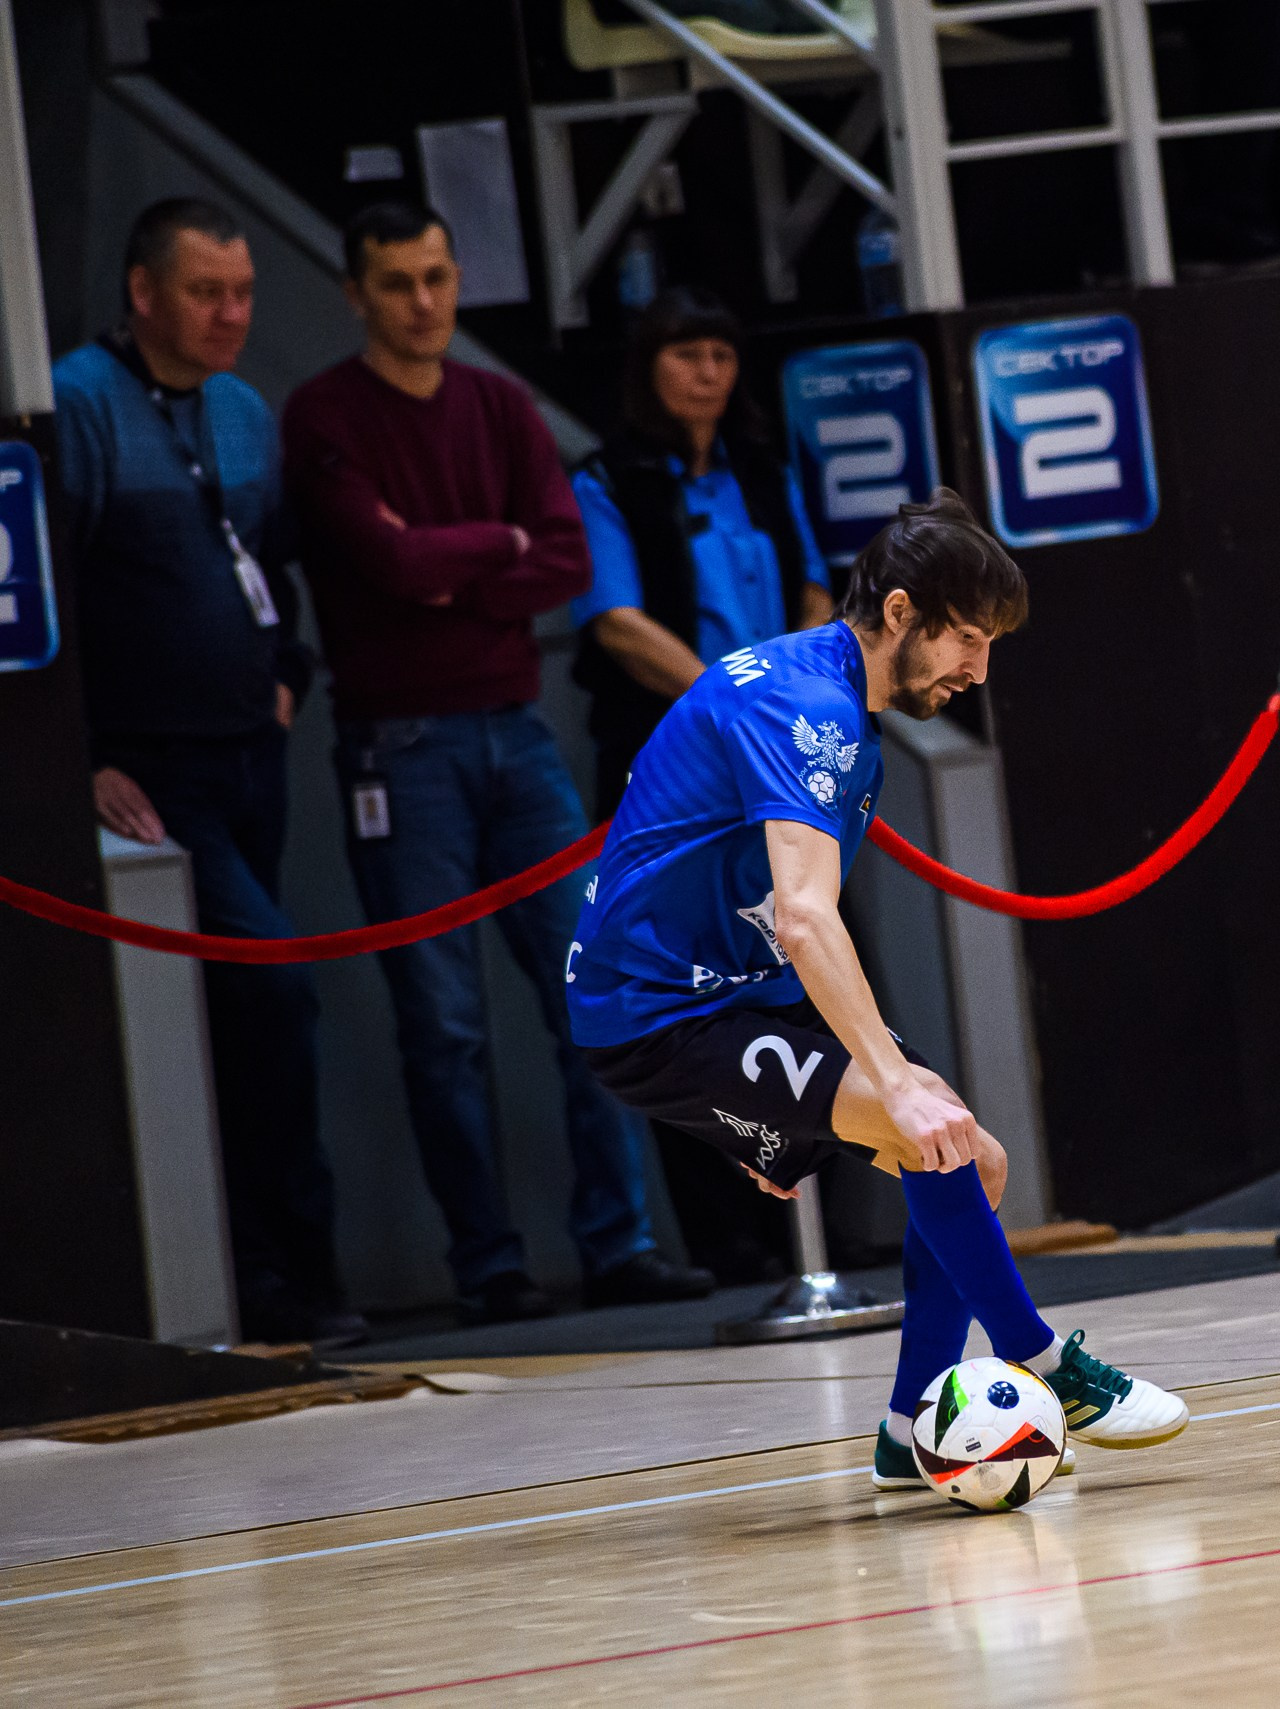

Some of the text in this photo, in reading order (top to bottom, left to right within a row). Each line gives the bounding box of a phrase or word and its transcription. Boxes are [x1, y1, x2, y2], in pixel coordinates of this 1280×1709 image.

[817, 412, 912, 521] 2
[1013, 386, 1122, 500] 2
[742, 1035, 824, 1102] 2
